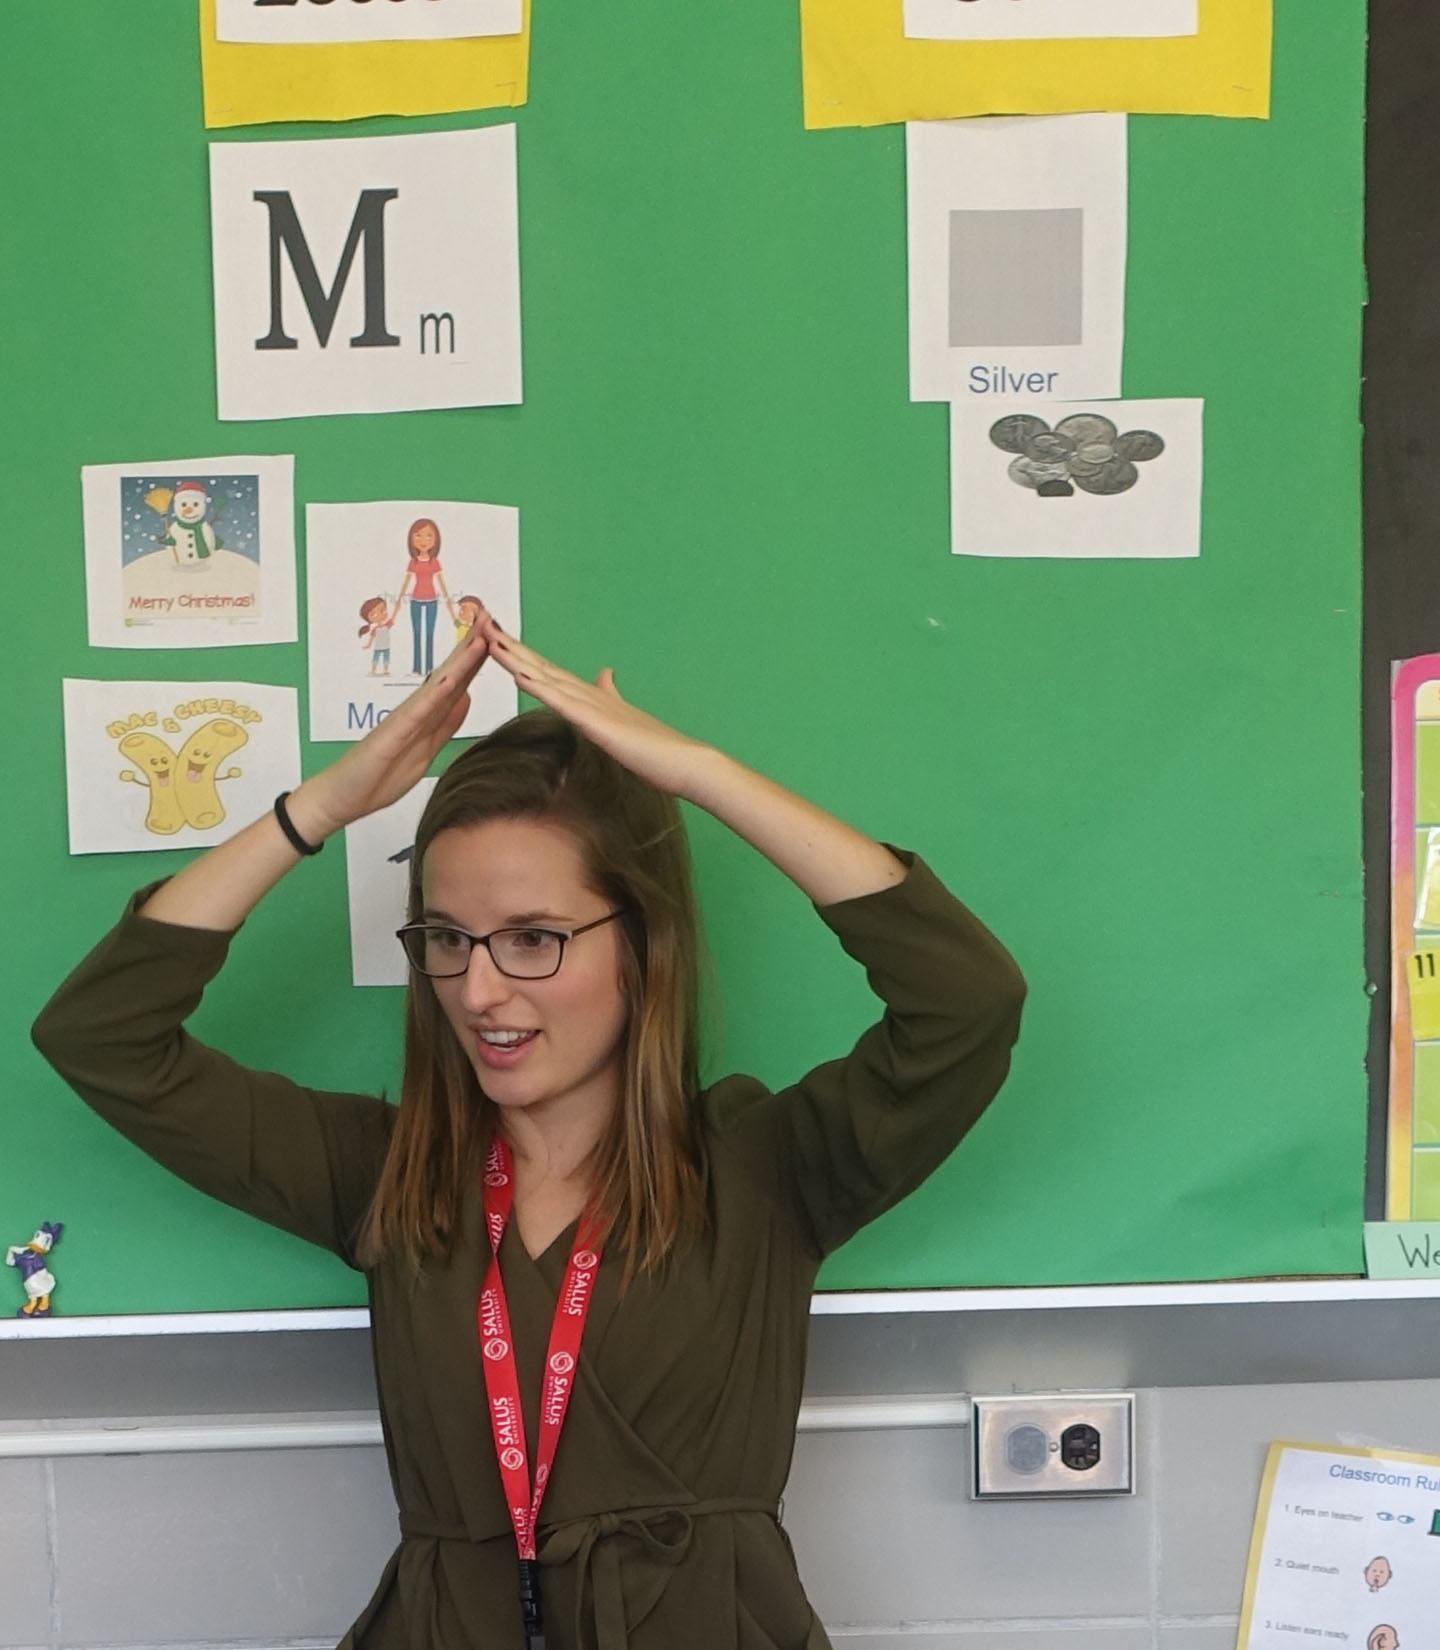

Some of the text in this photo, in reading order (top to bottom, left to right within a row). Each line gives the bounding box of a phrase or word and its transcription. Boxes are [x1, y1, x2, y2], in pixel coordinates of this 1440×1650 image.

[968, 365, 1060, 395] Silver
[128, 593, 255, 612] Merry Christmas!
[106, 711, 158, 739] MAC
[1414, 953, 1435, 978] 11
[568, 1271, 591, 1316] SALUS
[481, 1289, 498, 1337] SALUS
[548, 1376, 569, 1426] SALUS
[492, 1396, 514, 1446] SALUS
[1329, 1464, 1411, 1488] Classroom
[1294, 1505, 1316, 1519] Eyes
[1318, 1509, 1329, 1519] on
[1331, 1509, 1364, 1523] teacher
[1285, 1560, 1310, 1573] Quiet
[1312, 1563, 1340, 1575] mouth
[1275, 1621, 1302, 1634] Listen
[1324, 1628, 1350, 1641] ready
